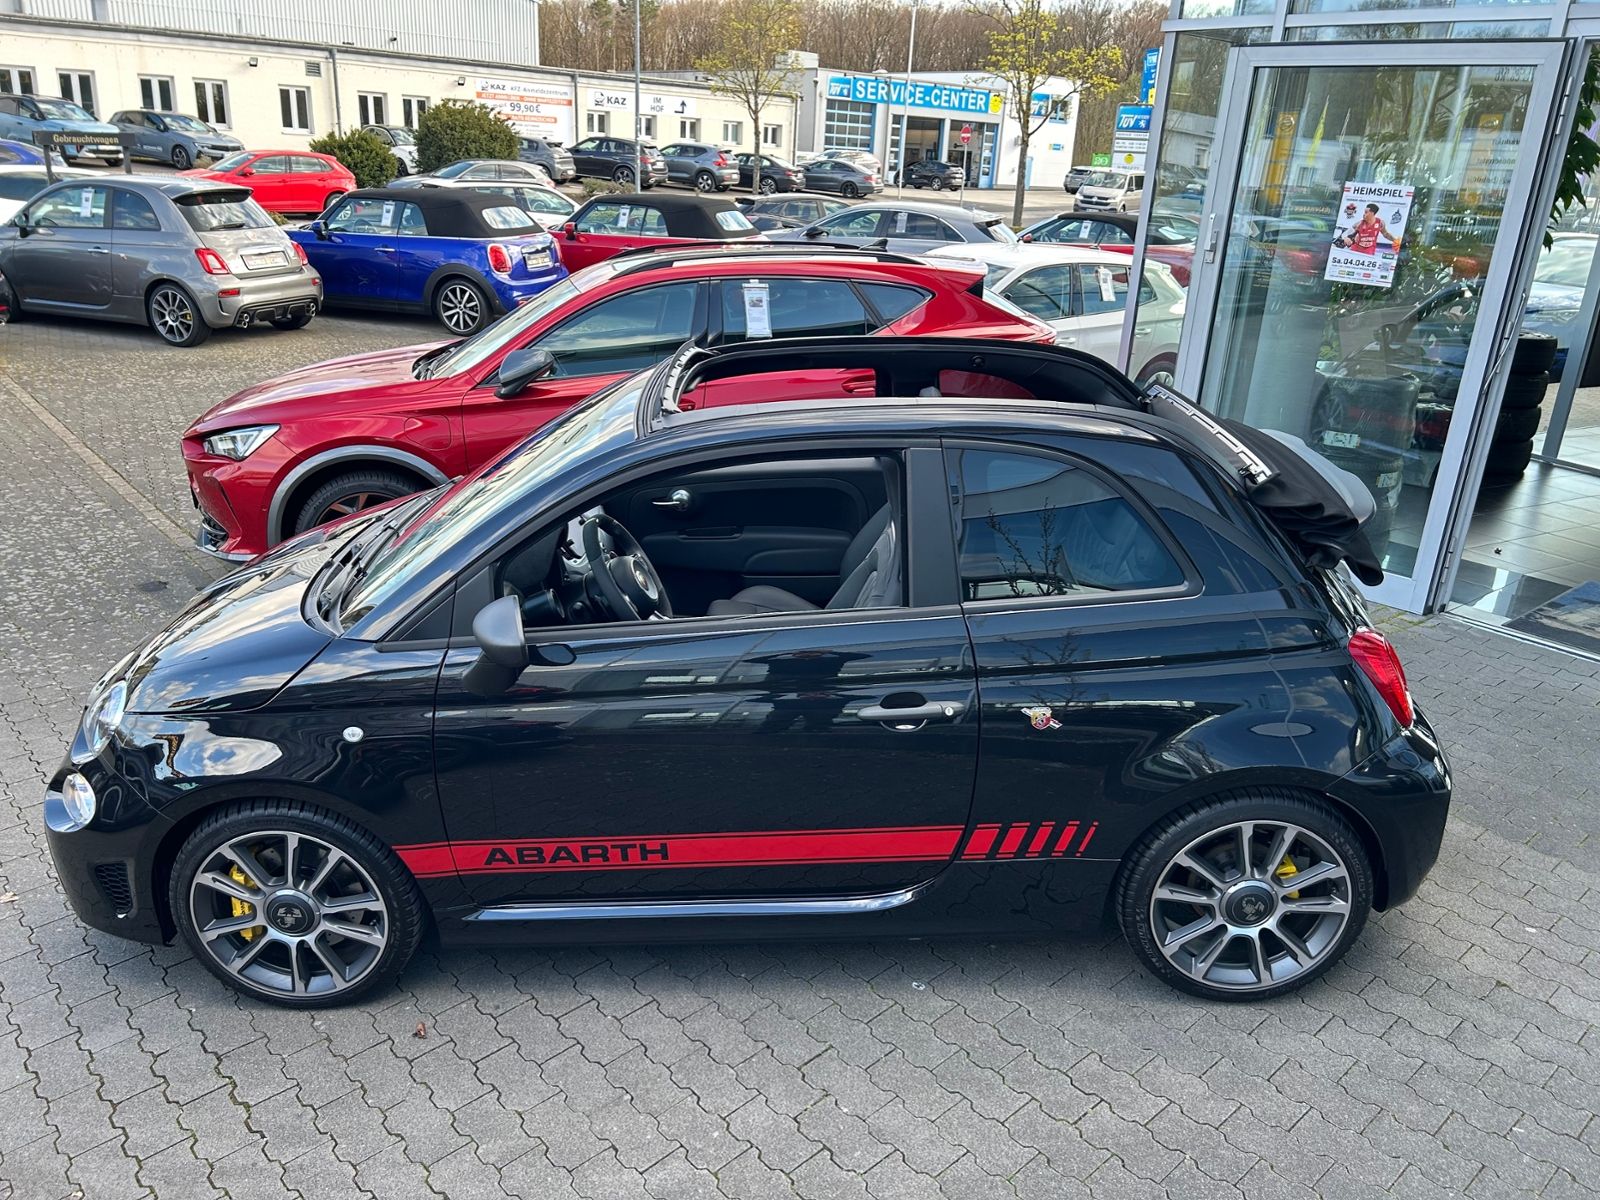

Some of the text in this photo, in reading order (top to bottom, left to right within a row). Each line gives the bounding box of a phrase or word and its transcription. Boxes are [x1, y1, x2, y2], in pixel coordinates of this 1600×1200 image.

[490, 83, 506, 91] KAZ
[606, 96, 627, 106] KAZ
[855, 80, 986, 111] SERVICE-CENTER
[53, 133, 119, 145] Gebrauchtwagen
[1352, 186, 1404, 198] HEIMSPIEL
[1343, 258, 1377, 268] 04.04.26
[484, 842, 669, 866] ABARTH
